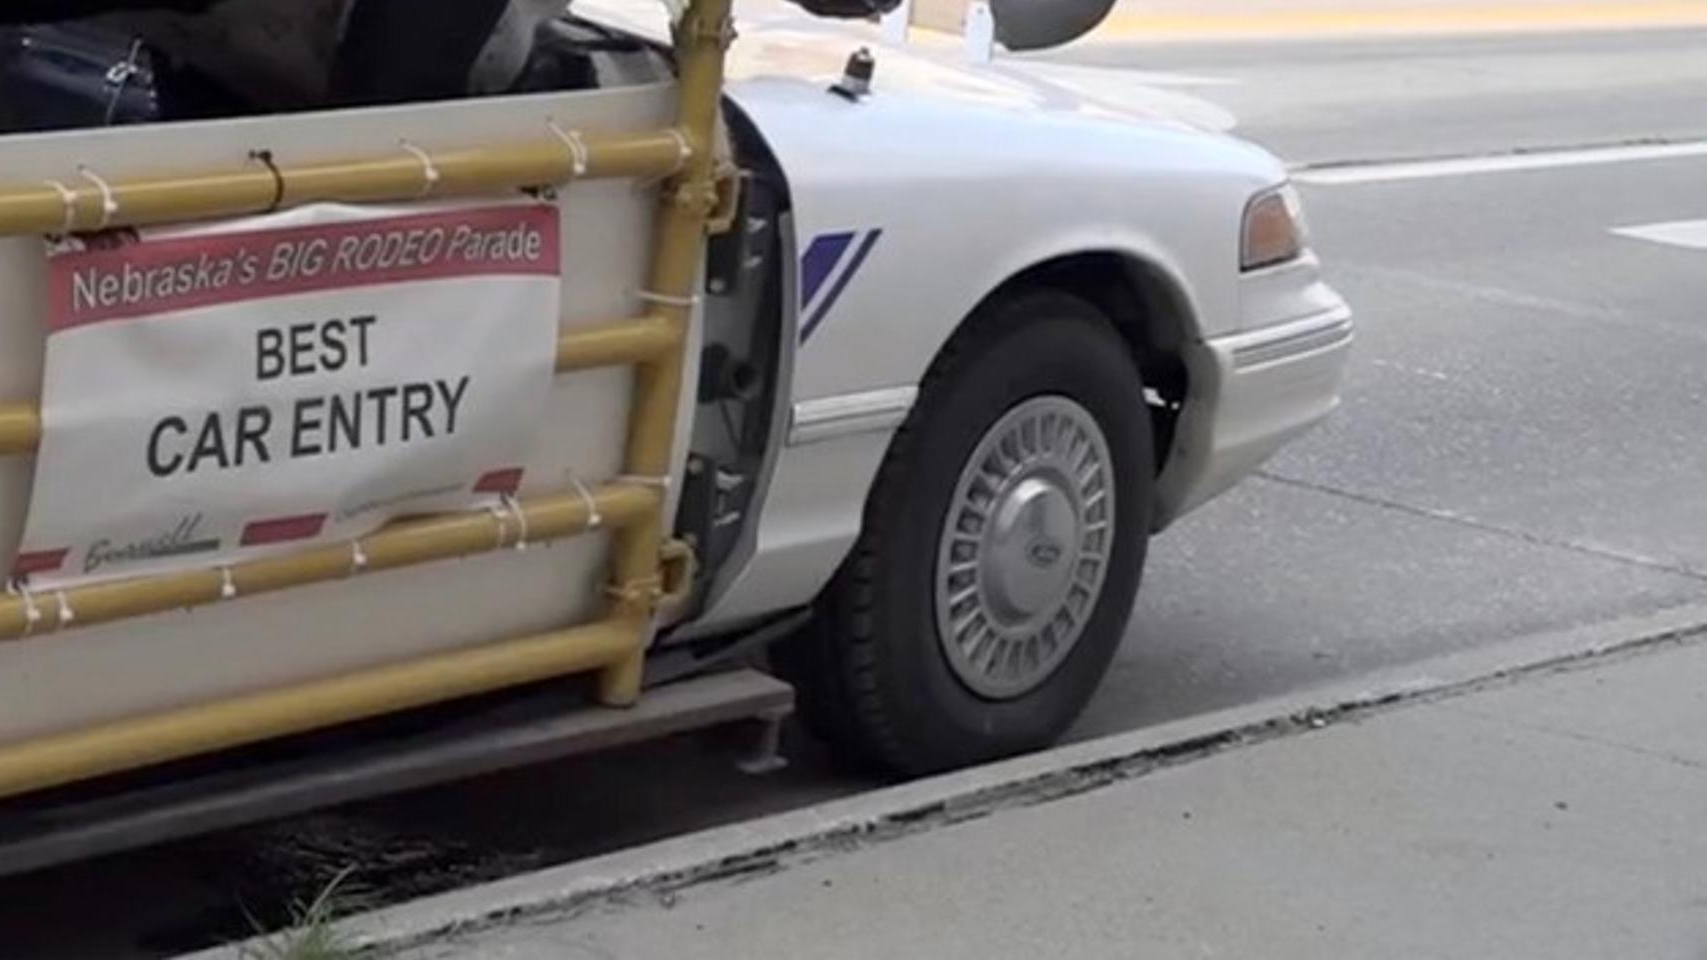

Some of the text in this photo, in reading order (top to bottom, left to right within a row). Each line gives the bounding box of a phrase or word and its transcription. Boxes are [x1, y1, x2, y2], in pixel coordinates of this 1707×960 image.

[72, 221, 541, 311] Nebraska's BIG RODEO Parade
[256, 315, 376, 380] BEST
[146, 375, 470, 478] CAR ENTRY
